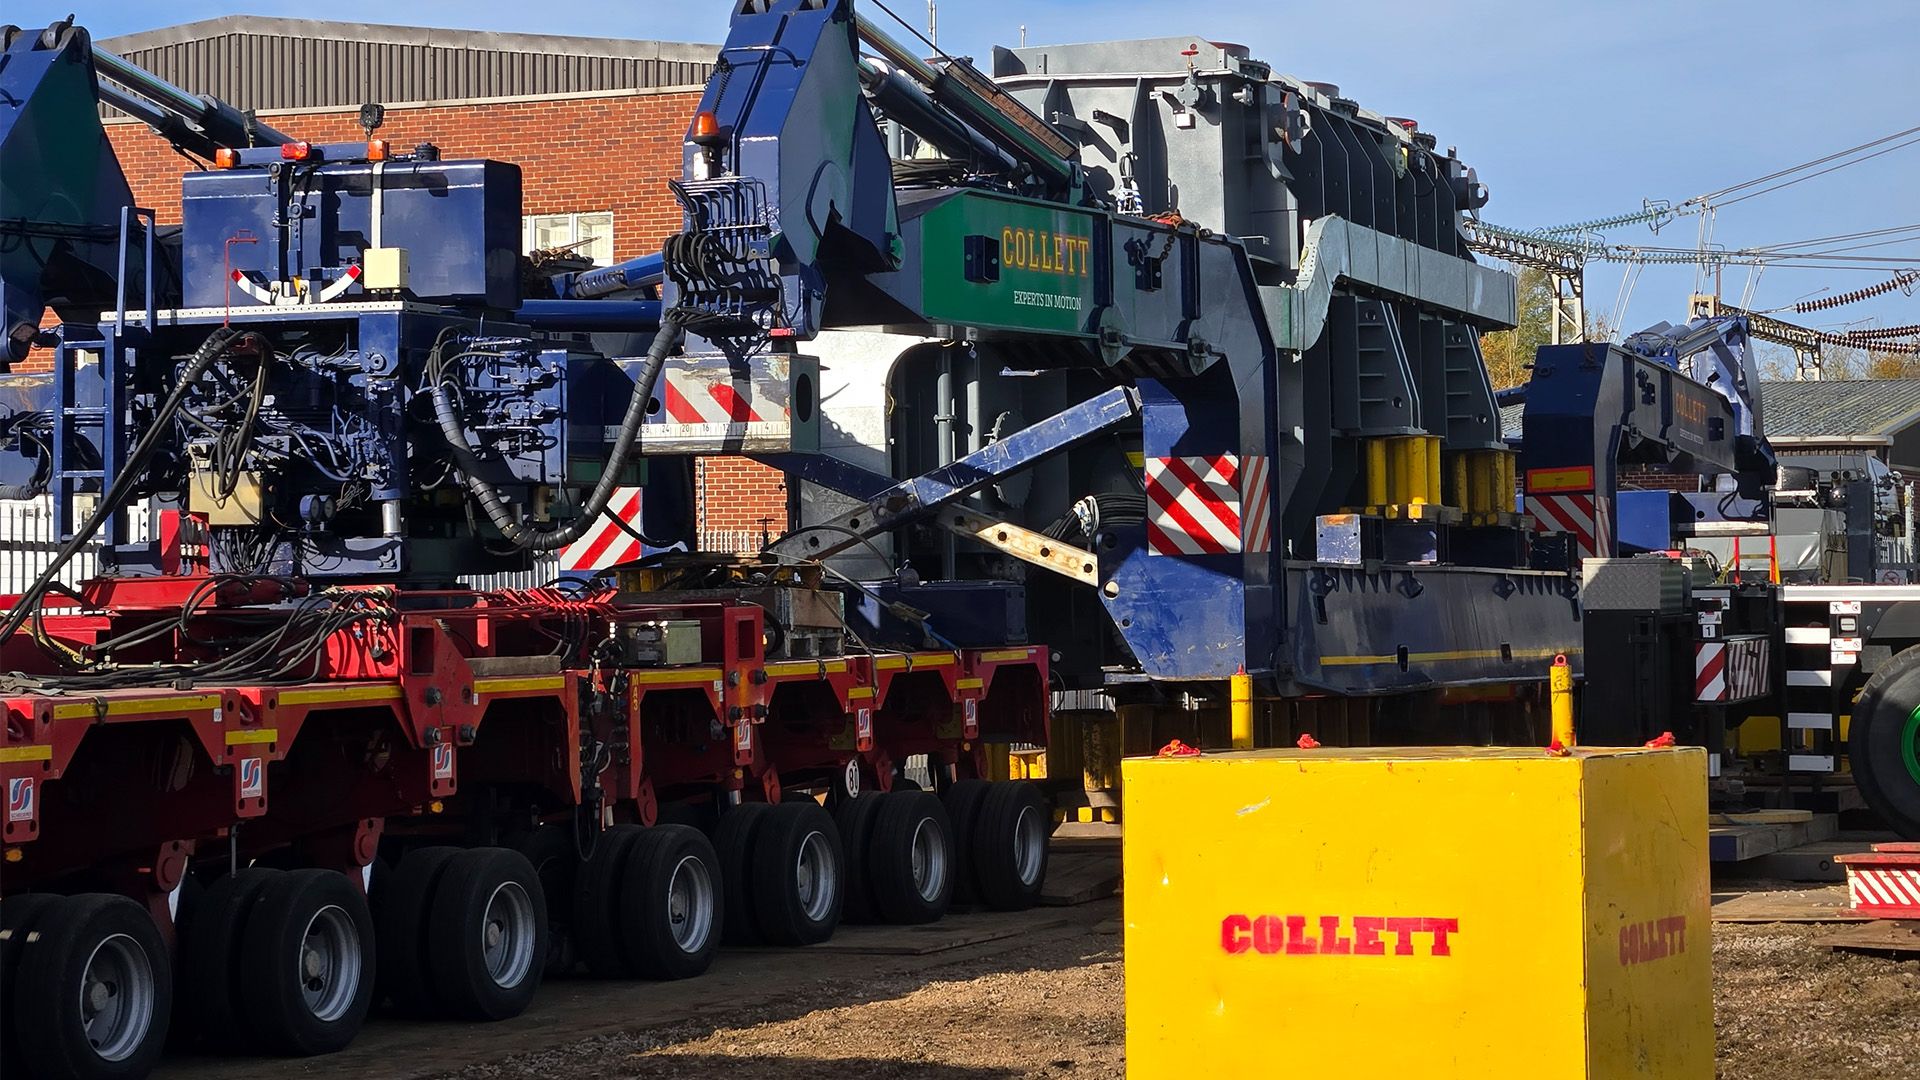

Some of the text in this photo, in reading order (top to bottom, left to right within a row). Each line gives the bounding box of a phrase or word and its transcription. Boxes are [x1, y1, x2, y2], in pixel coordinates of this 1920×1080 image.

[1003, 226, 1089, 277] COLLETT
[1013, 290, 1082, 311] EXPERTS IN MOTION
[661, 424, 670, 433] 24
[681, 423, 690, 433] 20
[702, 423, 710, 432] 16
[1705, 625, 1711, 637] 1
[1221, 914, 1459, 956] COLLETT
[1619, 915, 1686, 967] COLLETT
